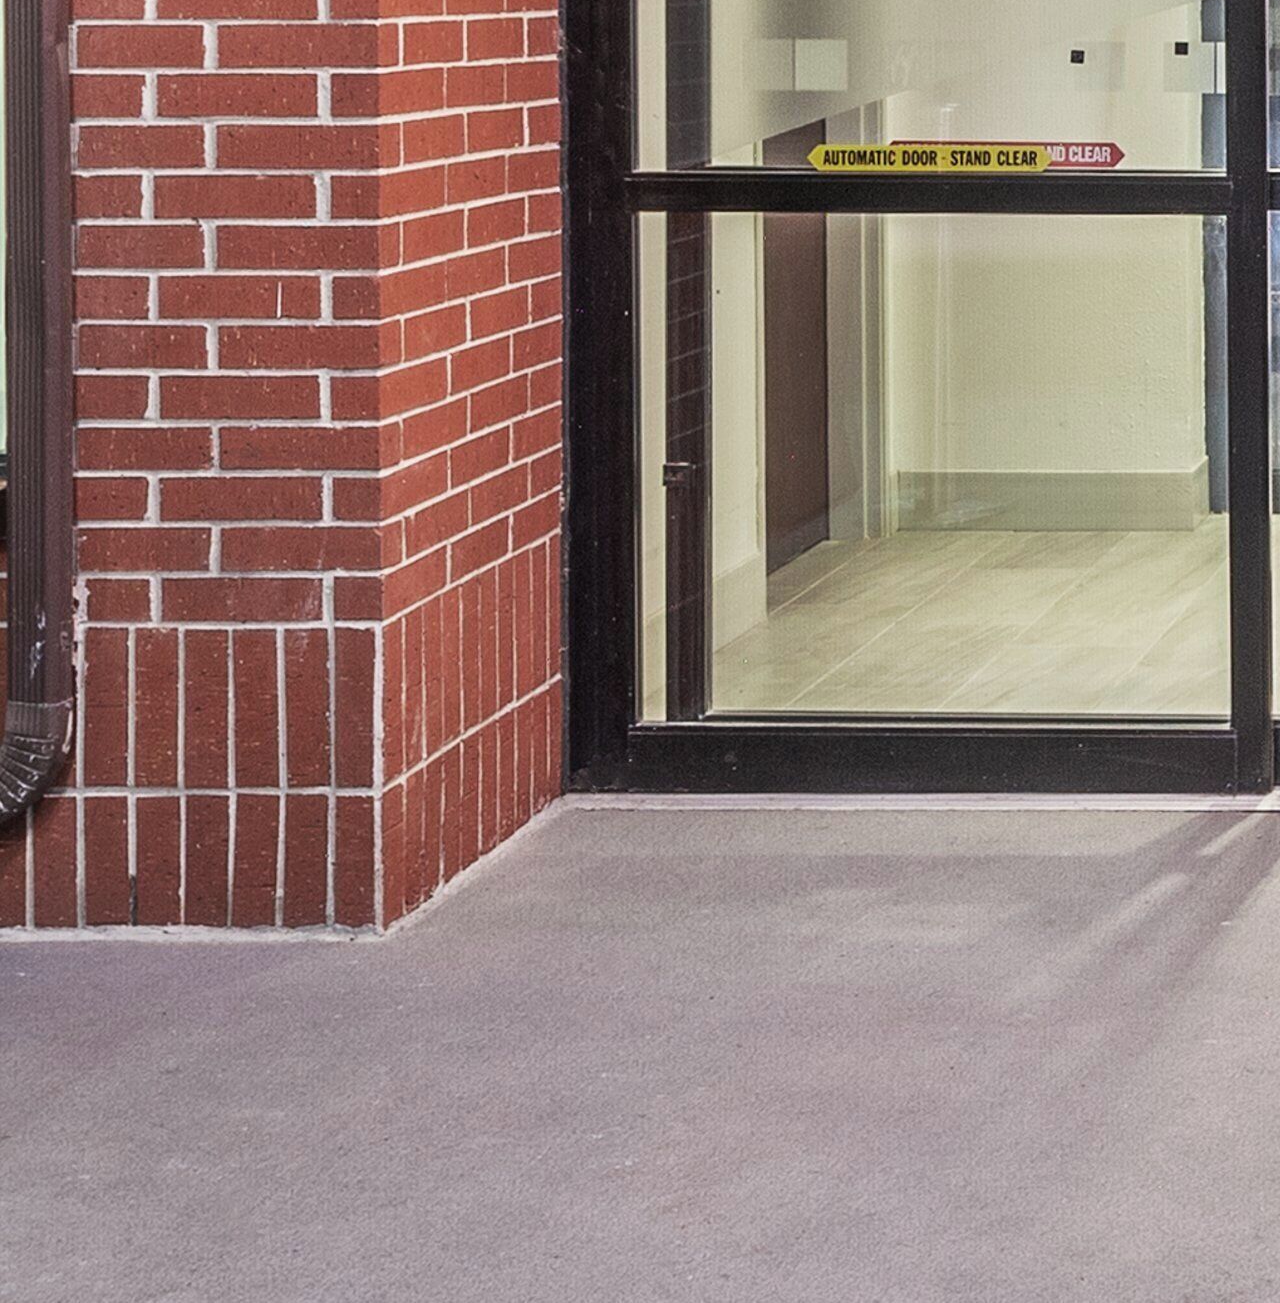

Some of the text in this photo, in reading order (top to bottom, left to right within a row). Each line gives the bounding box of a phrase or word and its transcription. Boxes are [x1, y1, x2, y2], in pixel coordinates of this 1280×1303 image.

[822, 150, 896, 166] AUTOMATIC
[901, 150, 938, 166] DOOR
[950, 150, 992, 166] STAND
[997, 150, 1038, 166] CLEAR
[1068, 145, 1112, 162] CLEAR
